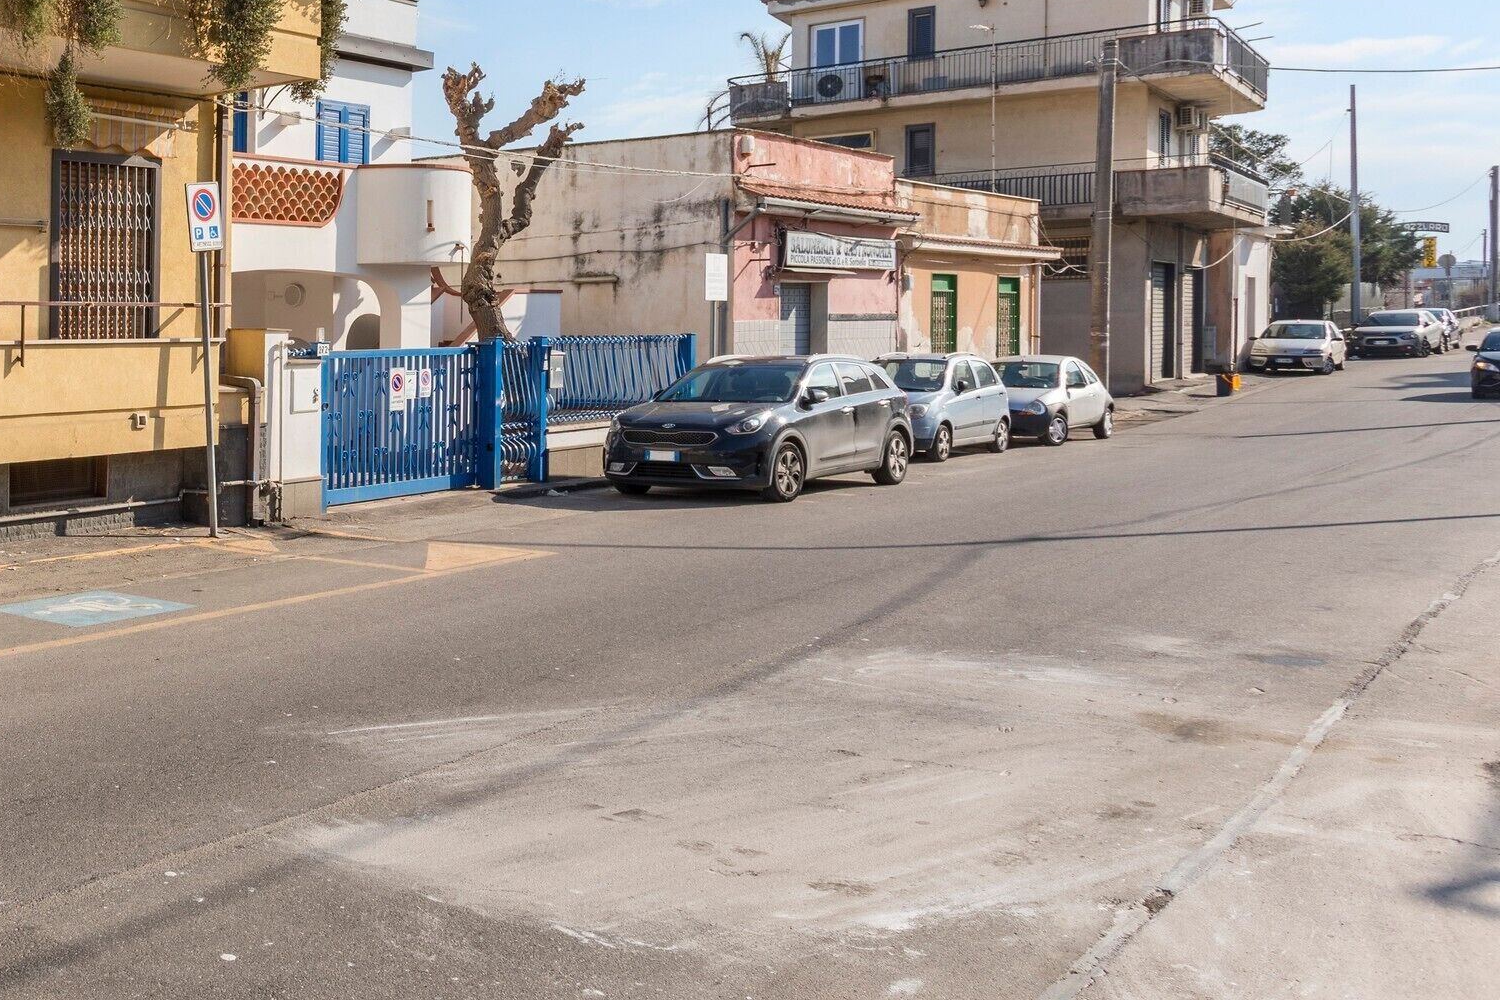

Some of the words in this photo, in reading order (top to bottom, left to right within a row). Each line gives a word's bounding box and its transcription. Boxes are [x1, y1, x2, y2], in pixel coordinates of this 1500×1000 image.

[196, 229, 201, 239] P
[790, 237, 834, 255] SALUMERIA
[791, 254, 809, 263] PICCOLA
[811, 255, 832, 265] PASSIONE
